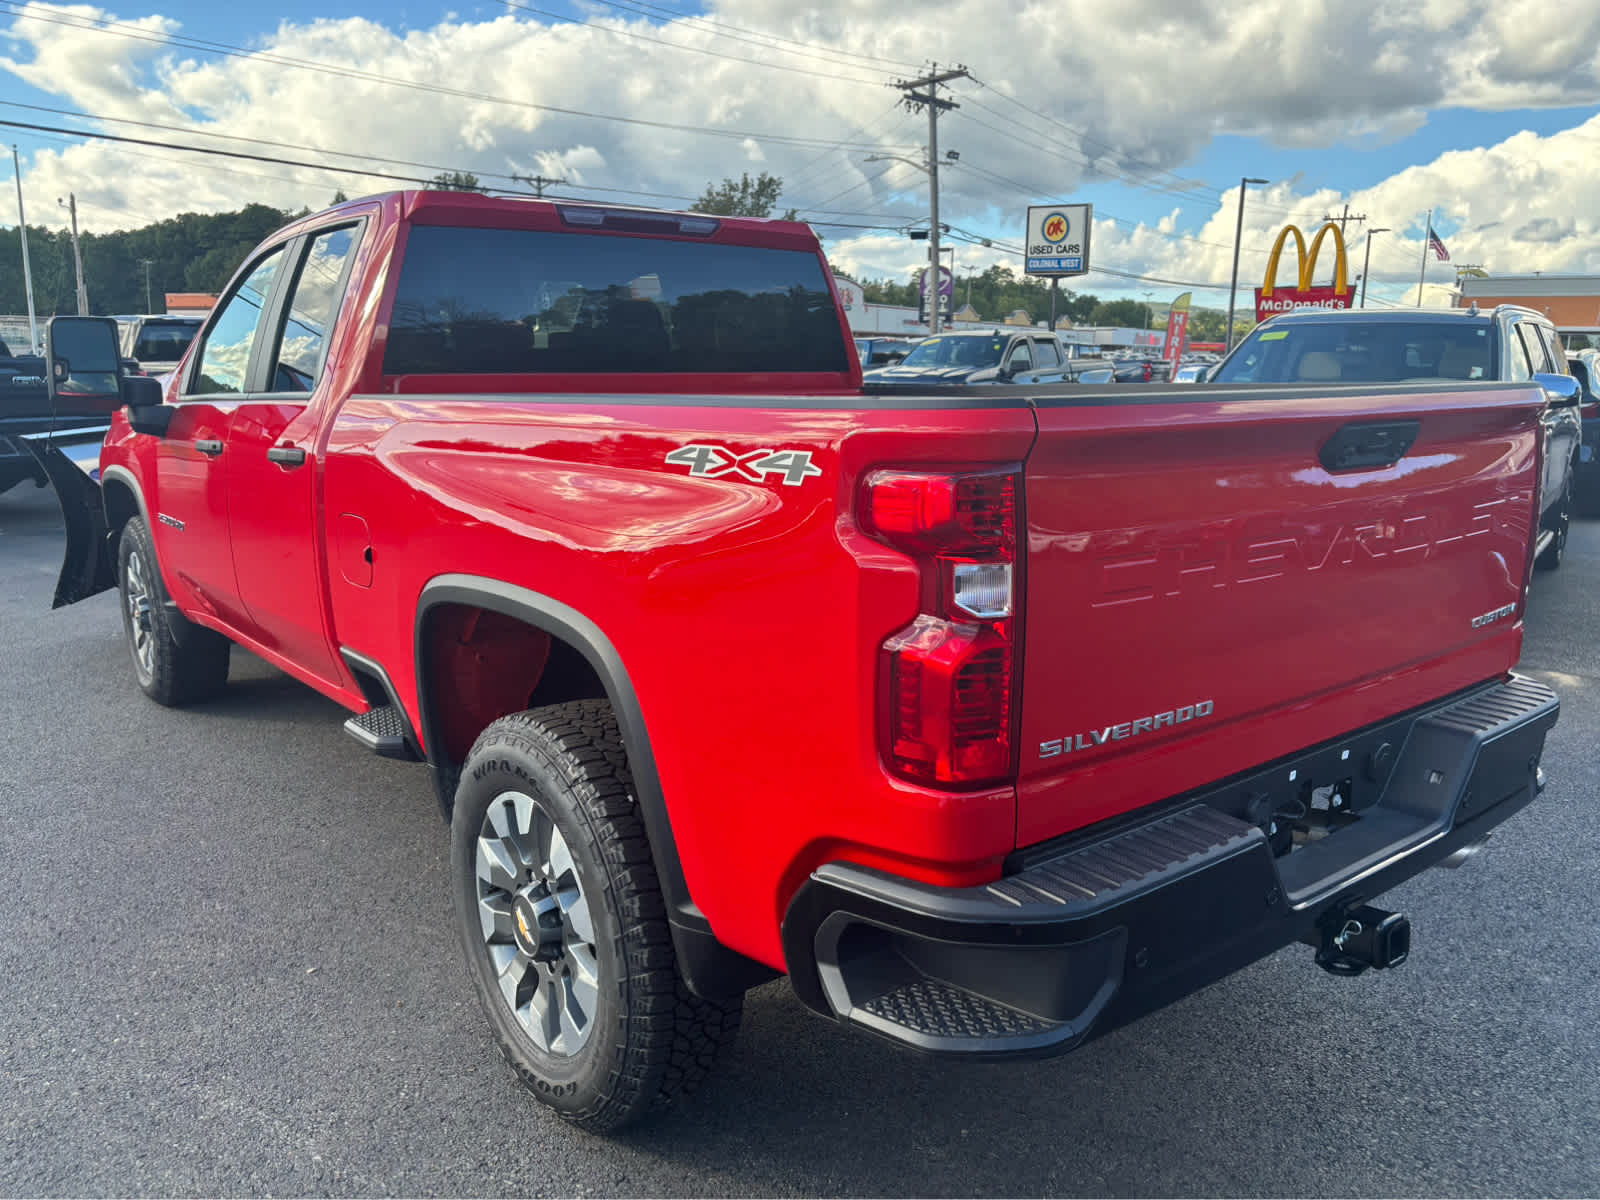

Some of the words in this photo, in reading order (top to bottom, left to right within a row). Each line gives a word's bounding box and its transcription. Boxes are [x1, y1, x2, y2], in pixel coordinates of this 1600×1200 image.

[1046, 217, 1064, 236] OK
[1029, 244, 1053, 255] USED
[1056, 243, 1080, 254] CARS
[1029, 259, 1058, 268] COLONIAL
[1060, 258, 1079, 268] WEST
[1260, 299, 1346, 312] McDonald's
[1472, 602, 1517, 629] CUSTOM
[1039, 699, 1214, 759] SILVERADO
